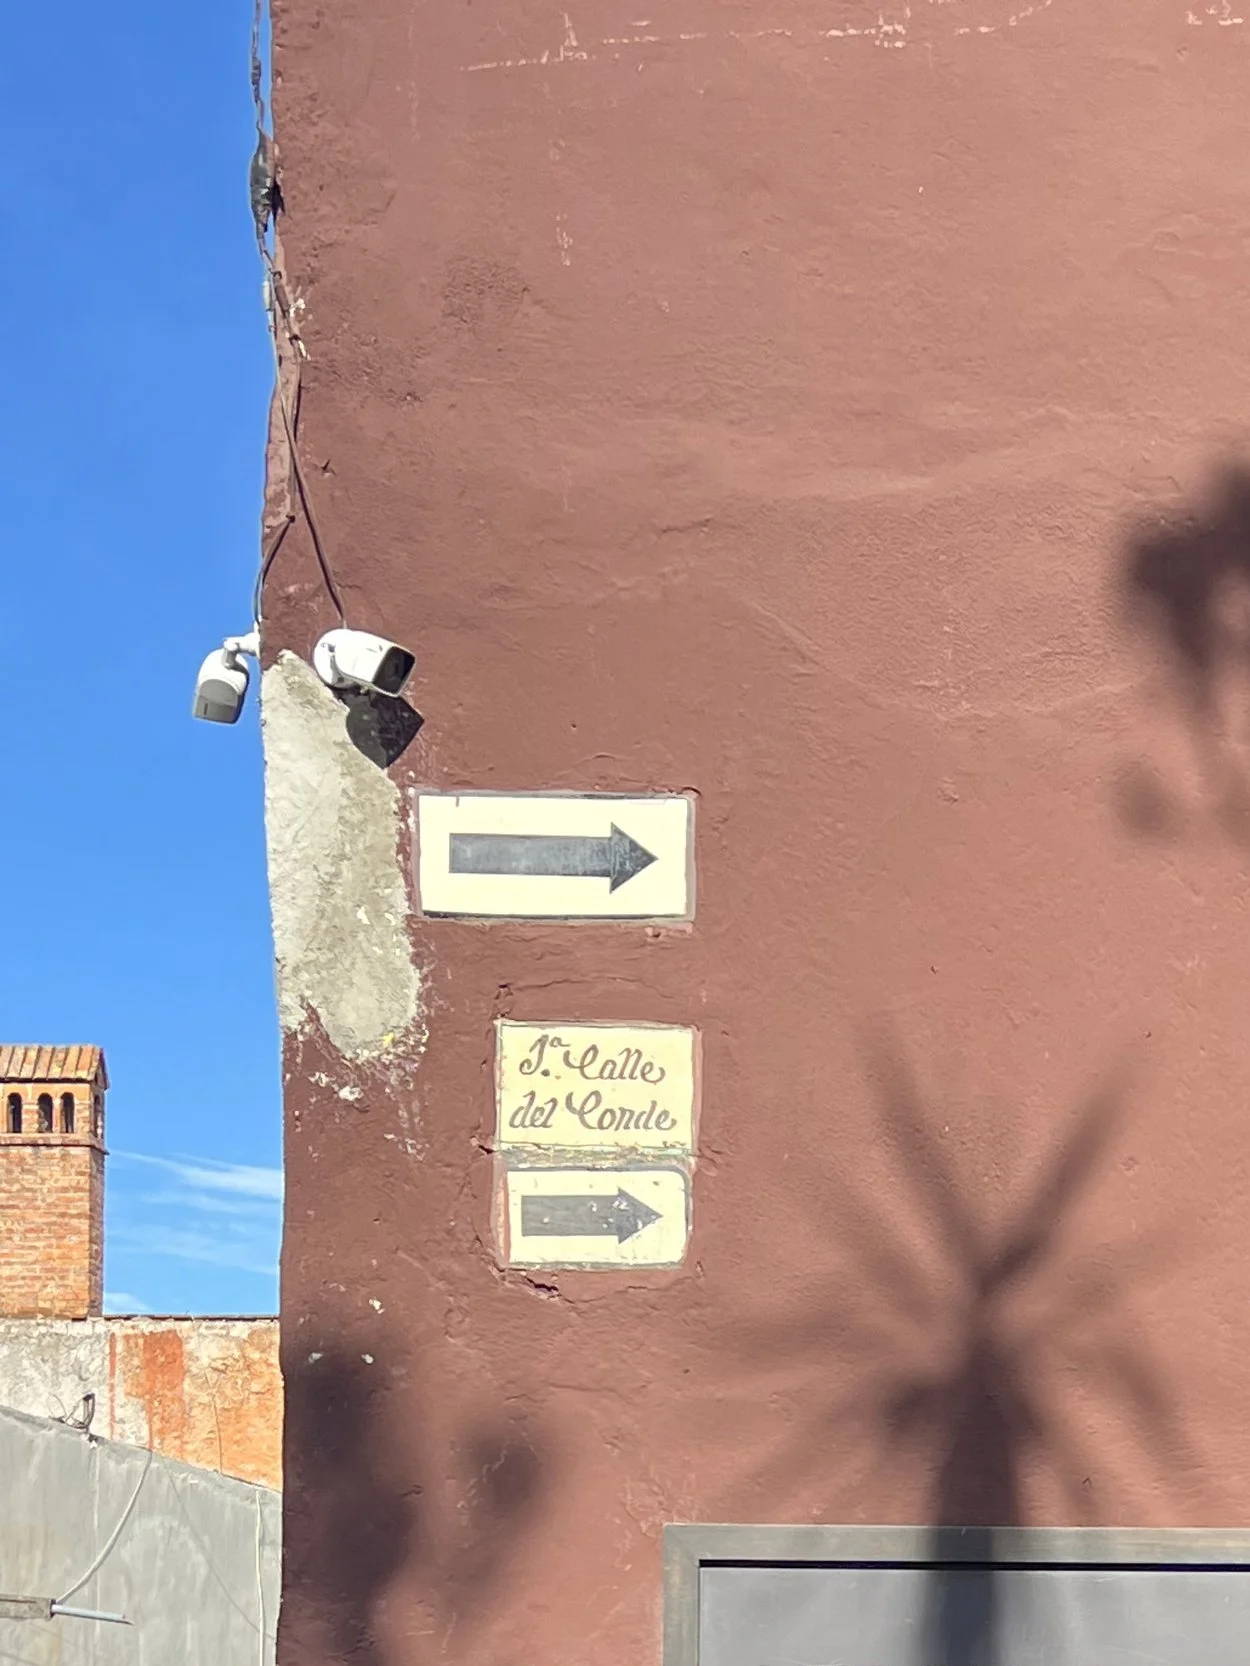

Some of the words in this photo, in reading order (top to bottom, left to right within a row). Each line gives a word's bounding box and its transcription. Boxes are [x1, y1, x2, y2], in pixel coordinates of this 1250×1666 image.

[563, 1044, 666, 1083] Calle
[509, 1090, 559, 1129] del
[565, 1090, 678, 1132] Conde
